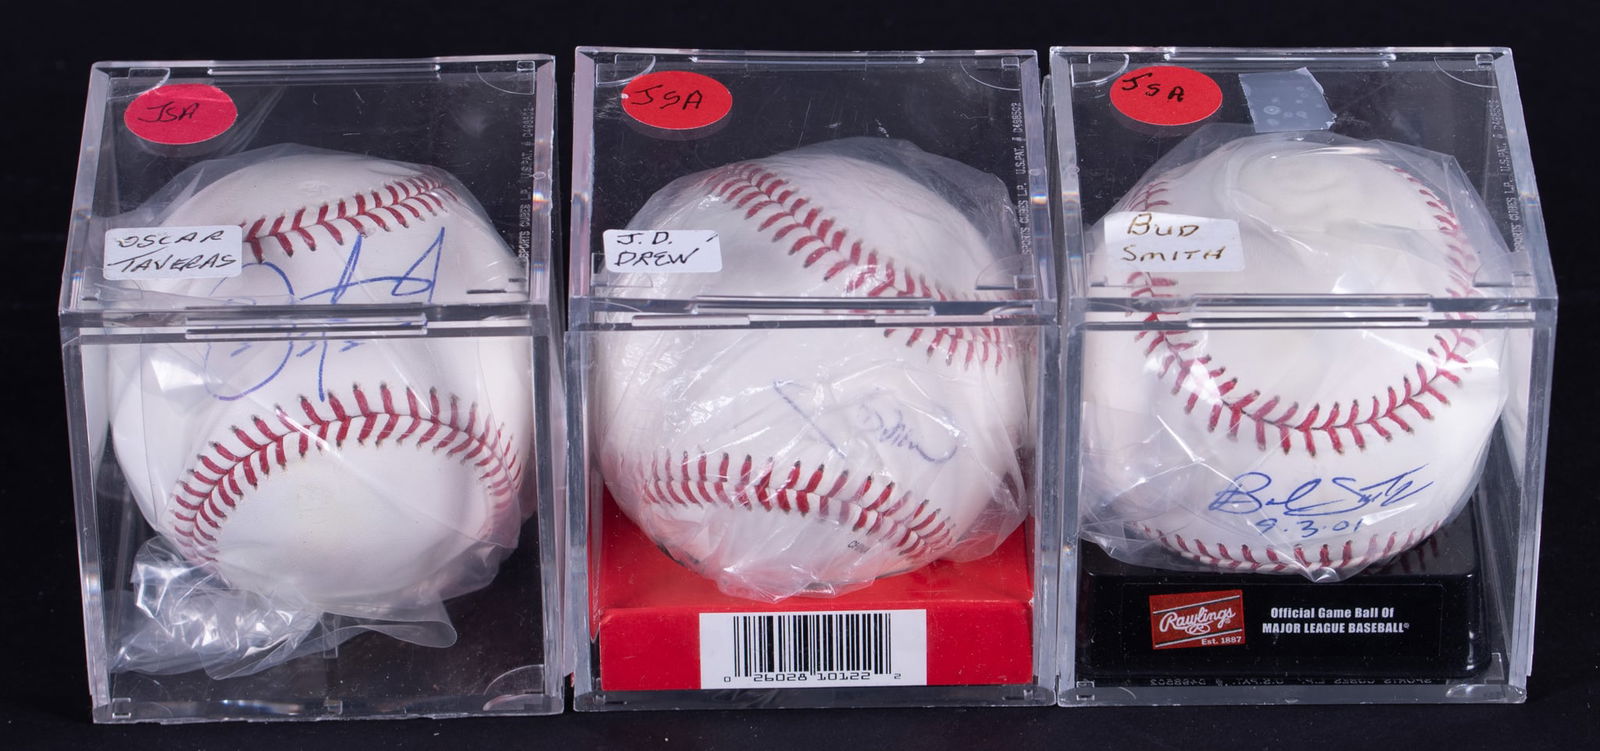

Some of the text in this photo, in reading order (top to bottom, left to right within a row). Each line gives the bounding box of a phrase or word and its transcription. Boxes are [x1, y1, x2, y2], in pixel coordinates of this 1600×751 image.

[630, 84, 703, 110] JSA
[1121, 72, 1185, 103] JSA
[137, 101, 199, 123] JSA
[117, 230, 224, 248] OSCAR
[518, 230, 530, 258] SPORTS
[107, 246, 237, 272] TAVERAS
[614, 248, 699, 267] DREW
[1159, 606, 1236, 636] Rawlings
[1270, 607, 1395, 619] Official Game Ball Of
[1262, 622, 1301, 634] MAJOR
[1304, 622, 1345, 634] LEAGUE
[1201, 636, 1243, 646] Est. 1887
[723, 675, 732, 683] 0
[753, 673, 808, 682] 26028
[816, 672, 871, 681] 10122
